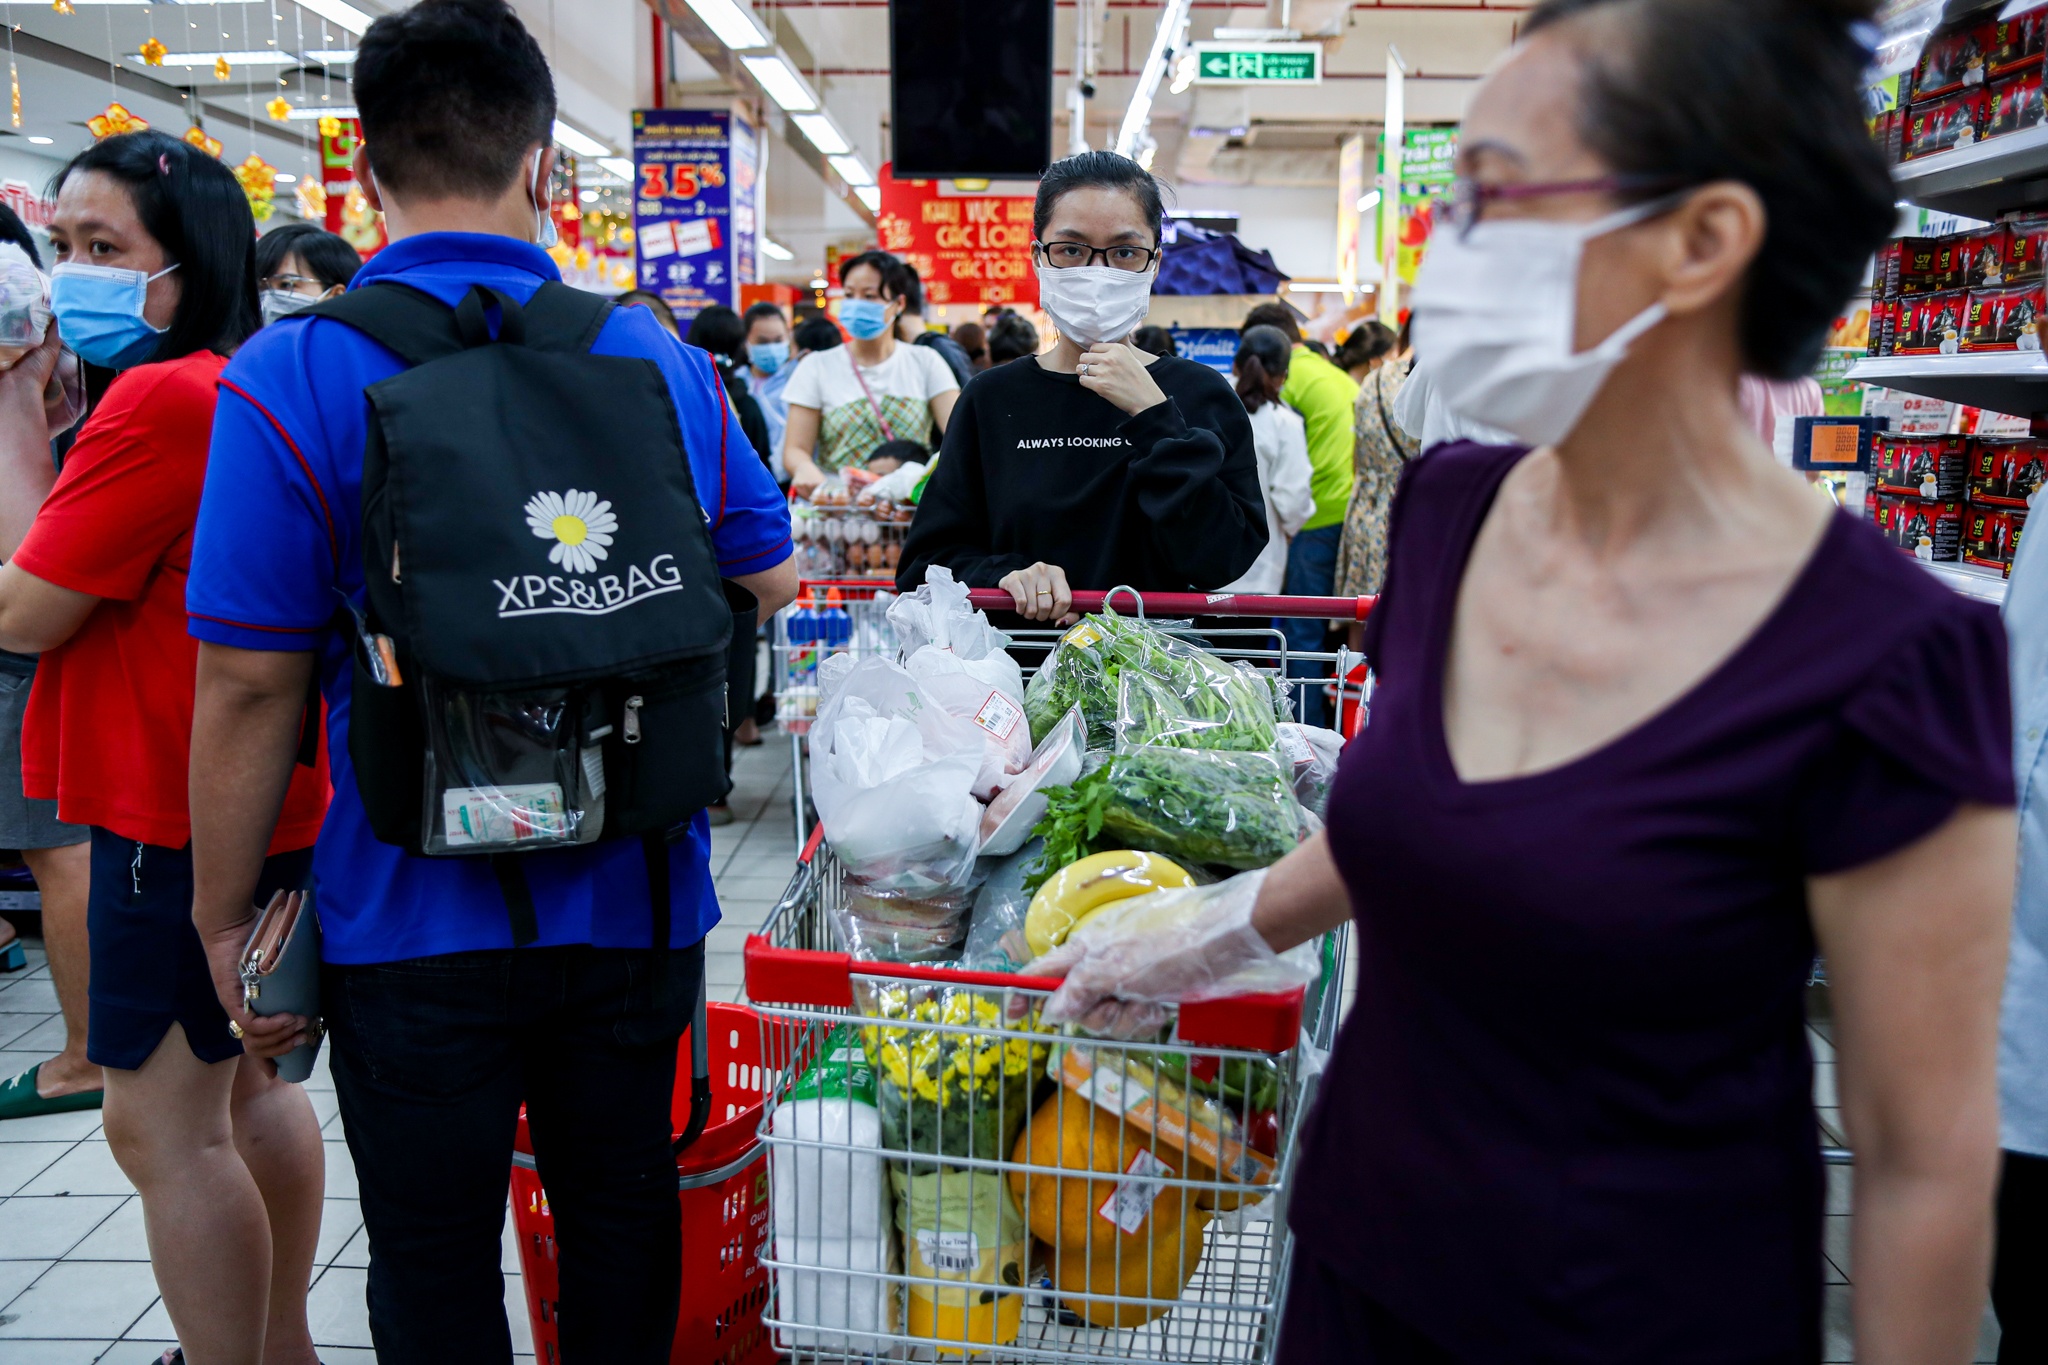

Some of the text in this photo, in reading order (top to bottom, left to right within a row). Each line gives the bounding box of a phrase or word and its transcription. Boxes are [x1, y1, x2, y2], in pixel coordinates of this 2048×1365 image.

[1267, 66, 1305, 78] EXIT
[1017, 438, 1064, 449] ALWAYS
[1067, 437, 1121, 448] LOOKING
[493, 554, 682, 611] XPS&BAG
